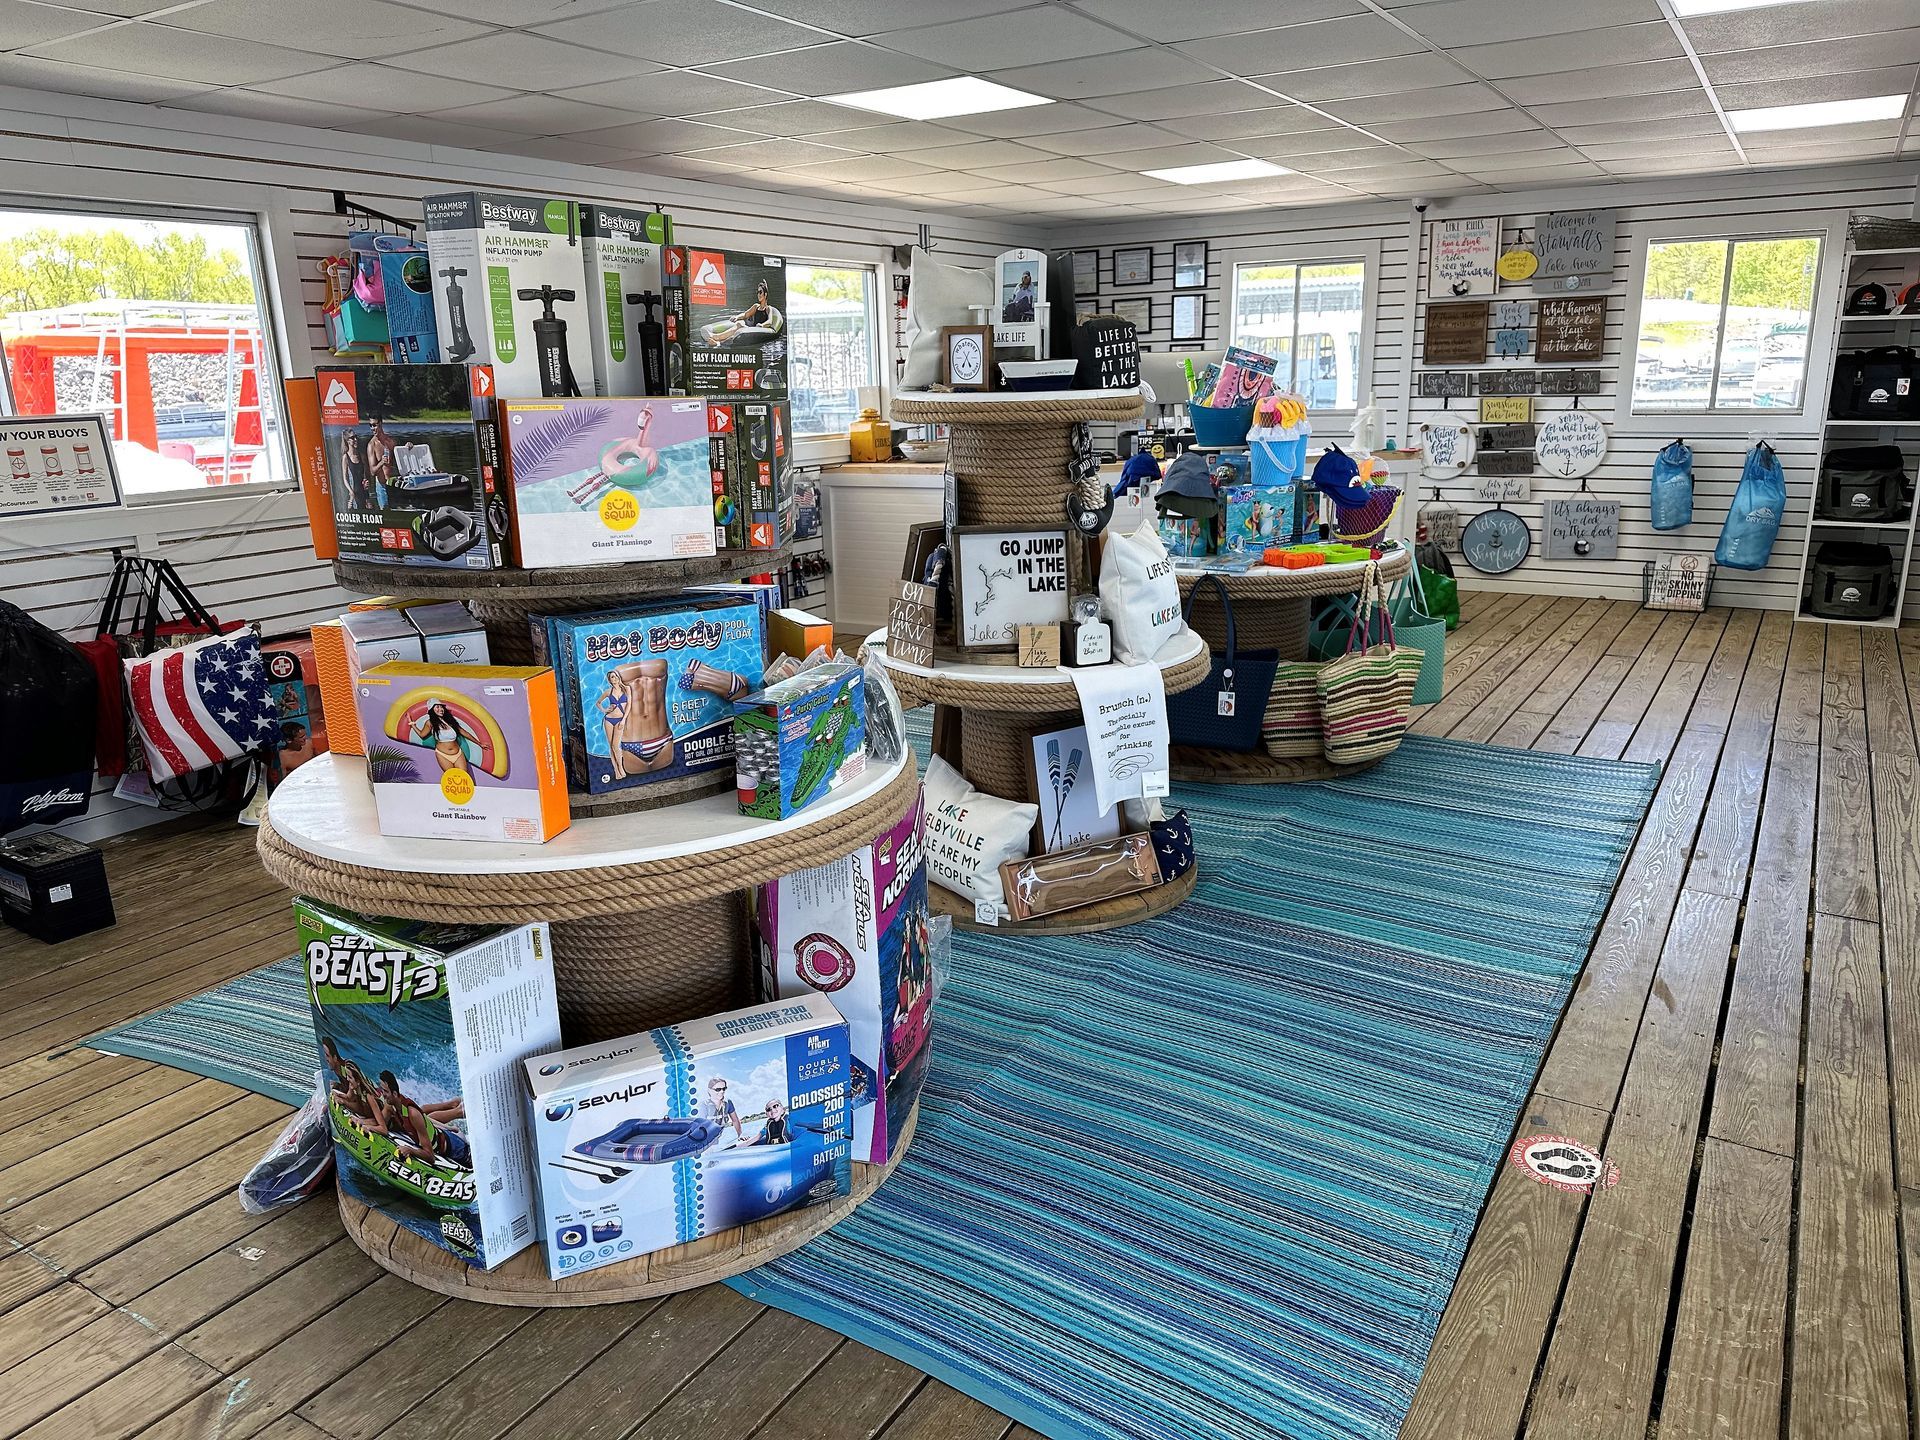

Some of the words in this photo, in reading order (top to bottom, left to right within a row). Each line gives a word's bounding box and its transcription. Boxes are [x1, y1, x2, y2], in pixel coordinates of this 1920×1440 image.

[427, 202, 437, 212] AIR
[427, 210, 450, 219] INFLATION
[481, 201, 538, 225] Bestway
[600, 212, 640, 235] Bestway
[1547, 215, 1584, 230] Welcome
[1589, 212, 1596, 225] to
[485, 236, 501, 245] AIR
[602, 243, 614, 253] AIR
[486, 248, 522, 256] INFLATION
[602, 254, 630, 263] INFLATION
[1545, 259, 1566, 273] lake
[1570, 258, 1600, 270] house
[1567, 301, 1601, 316] happens
[1545, 316, 1557, 326] at
[1557, 316, 1573, 325] the
[1574, 315, 1598, 325] lake
[1012, 332, 1025, 342] LIFE
[1098, 329, 1120, 343] LIFE
[1124, 326, 1133, 339] IS
[1560, 325, 1584, 340] stays
[1094, 342, 1137, 359] BETTER
[1543, 340, 1554, 352] at
[1556, 339, 1572, 351] the
[1573, 339, 1596, 351] lake
[693, 353, 709, 363] EASY
[711, 354, 730, 363] FLOAT
[732, 354, 756, 364] LOUNGE
[1101, 360, 1115, 373] AT
[1120, 356, 1136, 370] THE
[1102, 371, 1136, 388] LAKE
[1559, 413, 1584, 423] sorry
[10, 430, 45, 440] YOUR
[48, 428, 88, 438] BUOYS
[1545, 423, 1557, 433] for
[1559, 423, 1577, 432] what
[1584, 422, 1600, 432] said
[1540, 432, 1559, 443] when
[1577, 433, 1599, 441] were
[315, 446, 324, 471] Float
[320, 473, 329, 494] Pool
[1480, 488, 1498, 500] ship
[607, 499, 632, 510] SUN
[1576, 500, 1618, 518] always
[336, 513, 361, 523] COOLER
[363, 514, 383, 524] FLOAT
[605, 511, 636, 521] SQUAD
[1500, 519, 1520, 535] get
[1553, 528, 1565, 540] on
[1570, 525, 1586, 538] the
[1591, 525, 1615, 539] dock
[1000, 540, 1020, 556] GO
[1024, 538, 1064, 555] JUMP
[1470, 543, 1496, 563] ship
[1017, 559, 1033, 574] IN
[1036, 558, 1065, 573] THE
[1146, 563, 1163, 580] LIFE
[1028, 575, 1066, 592] LAKE
[1681, 571, 1694, 580] NO
[1669, 580, 1703, 590] SKINNY
[902, 582, 924, 609] on
[1667, 589, 1701, 599] DIPPING
[725, 620, 747, 629] POOL
[889, 602, 932, 639] lake
[1152, 608, 1170, 627] LAKE
[585, 630, 643, 662] Hot
[648, 619, 723, 652] Body
[725, 629, 752, 640] FLOAT
[969, 623, 999, 642] Lake
[892, 636, 933, 665] time
[1034, 655, 1058, 665] life
[672, 703, 678, 712] 6
[682, 698, 706, 710] FEET
[797, 702, 812, 715] Party
[1099, 698, 1134, 715] Brunch
[1137, 693, 1151, 705] (n.)
[673, 711, 700, 724] TALL!
[1133, 720, 1156, 728] excuse
[684, 735, 726, 753] DOUBLE
[448, 776, 467, 785] SUN
[445, 786, 471, 795] SQUAD
[938, 800, 968, 822] LAKE
[1069, 832, 1091, 846] lake
[895, 830, 917, 874] SEA
[939, 844, 959, 863] ARE
[962, 854, 980, 871] MY
[934, 860, 976, 890] PEOPLE.
[852, 854, 866, 952] NORMUS
[861, 878, 871, 922] SEA
[330, 935, 375, 950] SEA
[306, 940, 411, 1013] BEAST
[410, 966, 438, 999] 3
[716, 1011, 777, 1032] COLOSSUS
[780, 1005, 807, 1020] 200
[720, 1025, 747, 1038] BOAT
[749, 1020, 773, 1033] BOTE
[775, 1012, 813, 1027] BATEAU
[808, 1036, 819, 1047] AIR
[811, 1039, 830, 1050] TIGHT
[568, 1046, 637, 1069] sevylor
[799, 1056, 838, 1071] DOUBLE
[799, 1066, 825, 1077] LOCK
[578, 1081, 657, 1110] sevylor
[791, 1082, 845, 1110] COLOSSUS
[823, 1097, 844, 1114] 200
[822, 1113, 844, 1129] BOAT
[823, 1128, 845, 1145] BOTE
[813, 1145, 845, 1167] BATEAU
[1514, 1142, 1523, 1166] STAND
[1522, 1164, 1541, 1182] HERE
[388, 1160, 422, 1186] SEA
